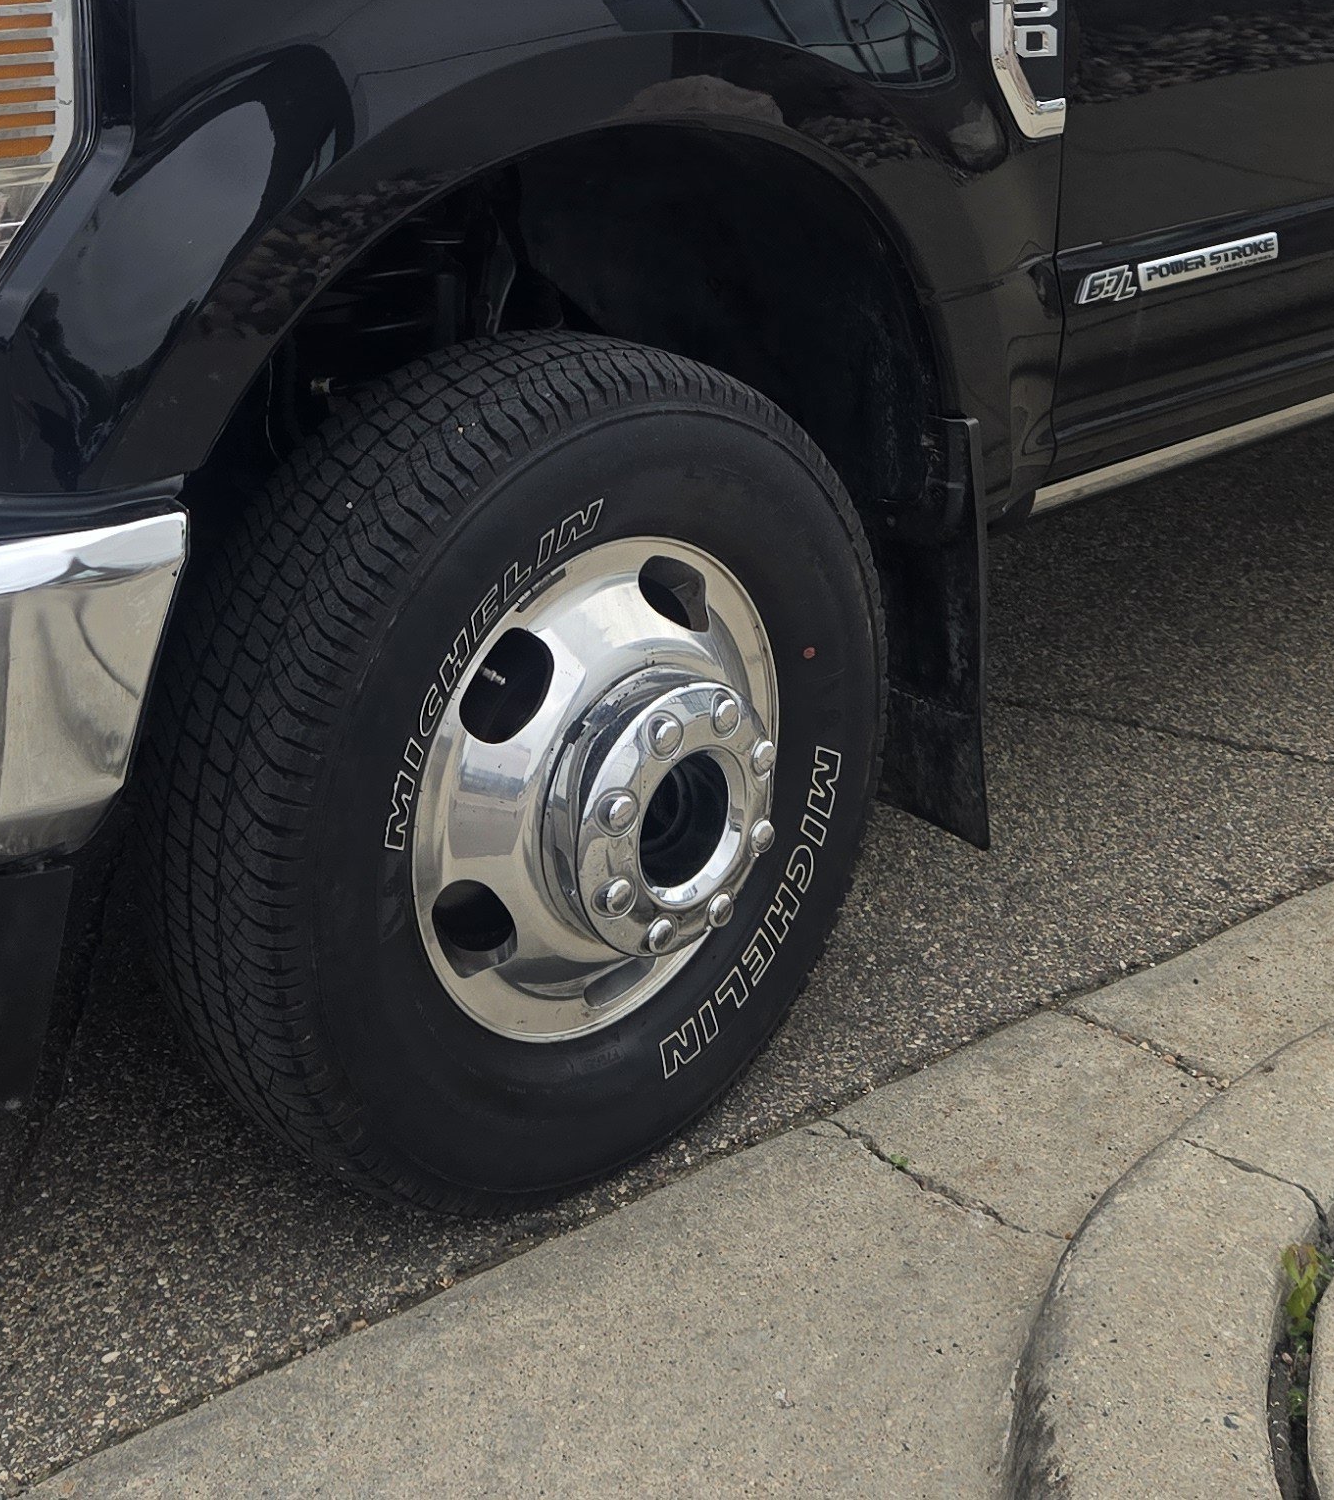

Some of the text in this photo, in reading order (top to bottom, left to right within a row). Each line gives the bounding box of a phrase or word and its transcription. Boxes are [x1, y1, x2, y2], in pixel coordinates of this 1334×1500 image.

[1147, 254, 1206, 282] POWER
[1209, 237, 1275, 266] STROKE
[384, 498, 605, 852] MICHELIN
[659, 745, 842, 1079] MICHELIN
